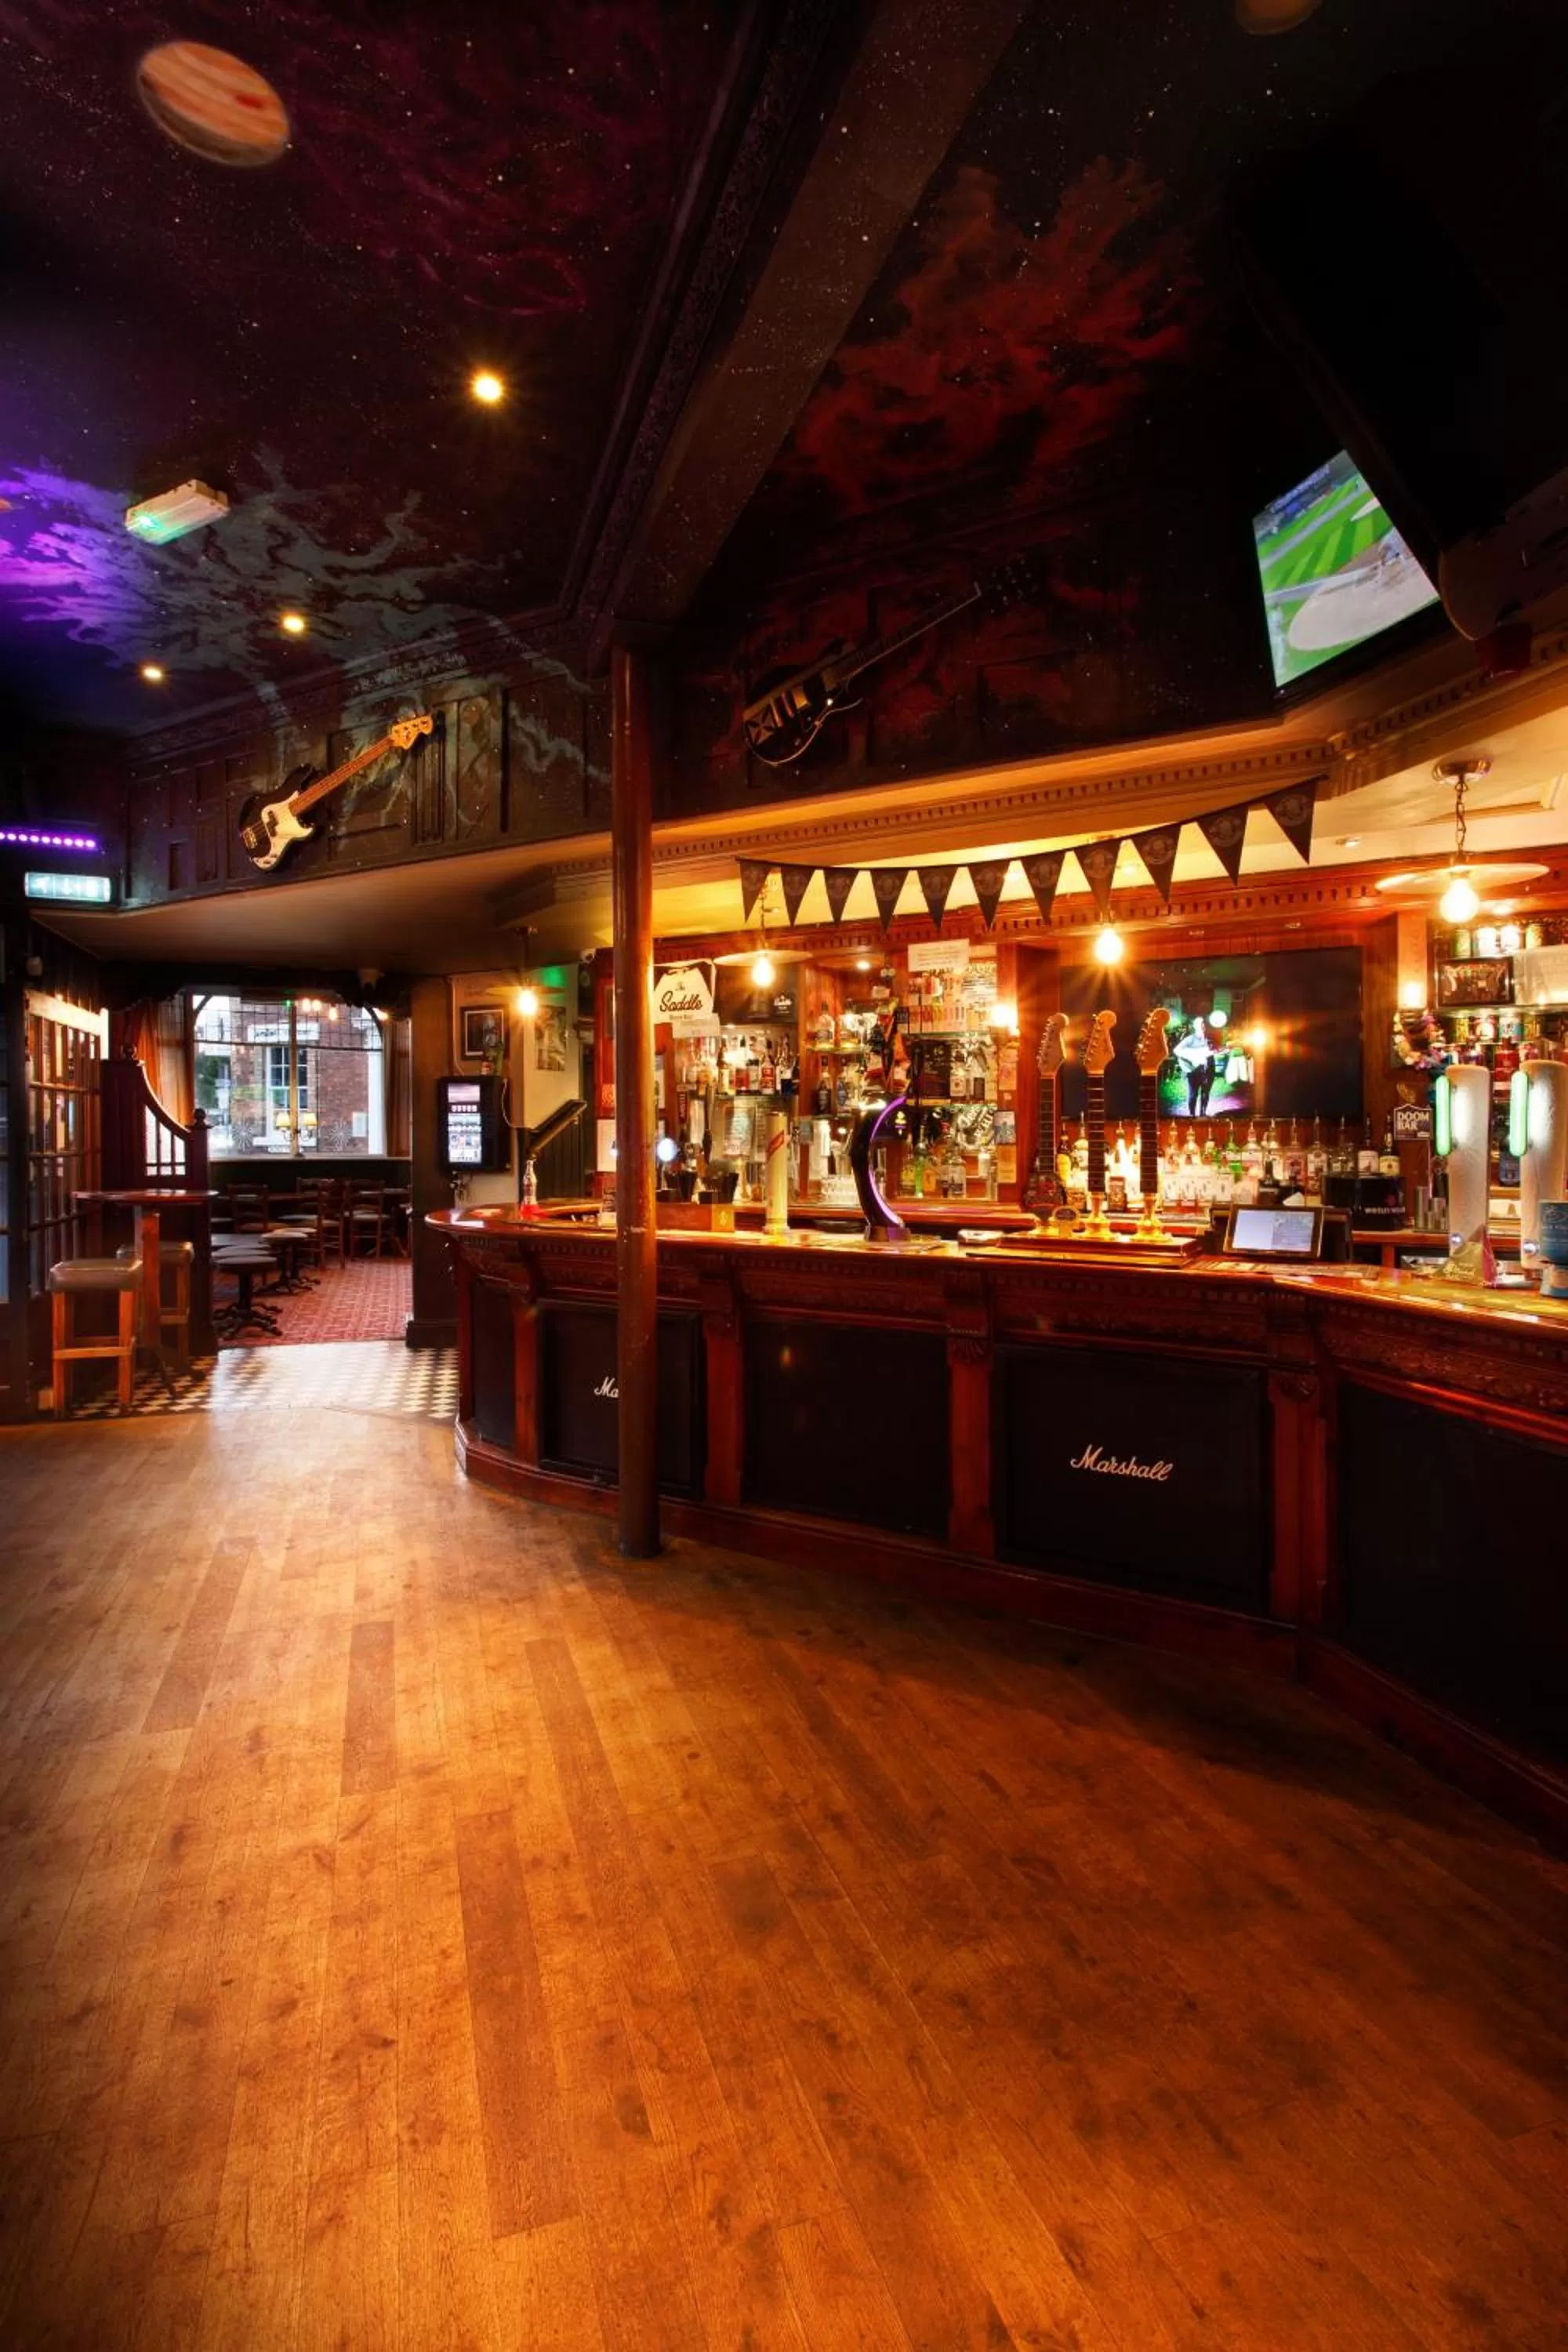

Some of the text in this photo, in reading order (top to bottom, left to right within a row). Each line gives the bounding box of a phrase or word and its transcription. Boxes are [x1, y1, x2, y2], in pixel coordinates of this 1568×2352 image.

[659, 990, 702, 1011] Saddle
[1397, 1112, 1429, 1122] DOOM
[1398, 1120, 1418, 1130] BAR
[1070, 1443, 1174, 1481] Marshall
